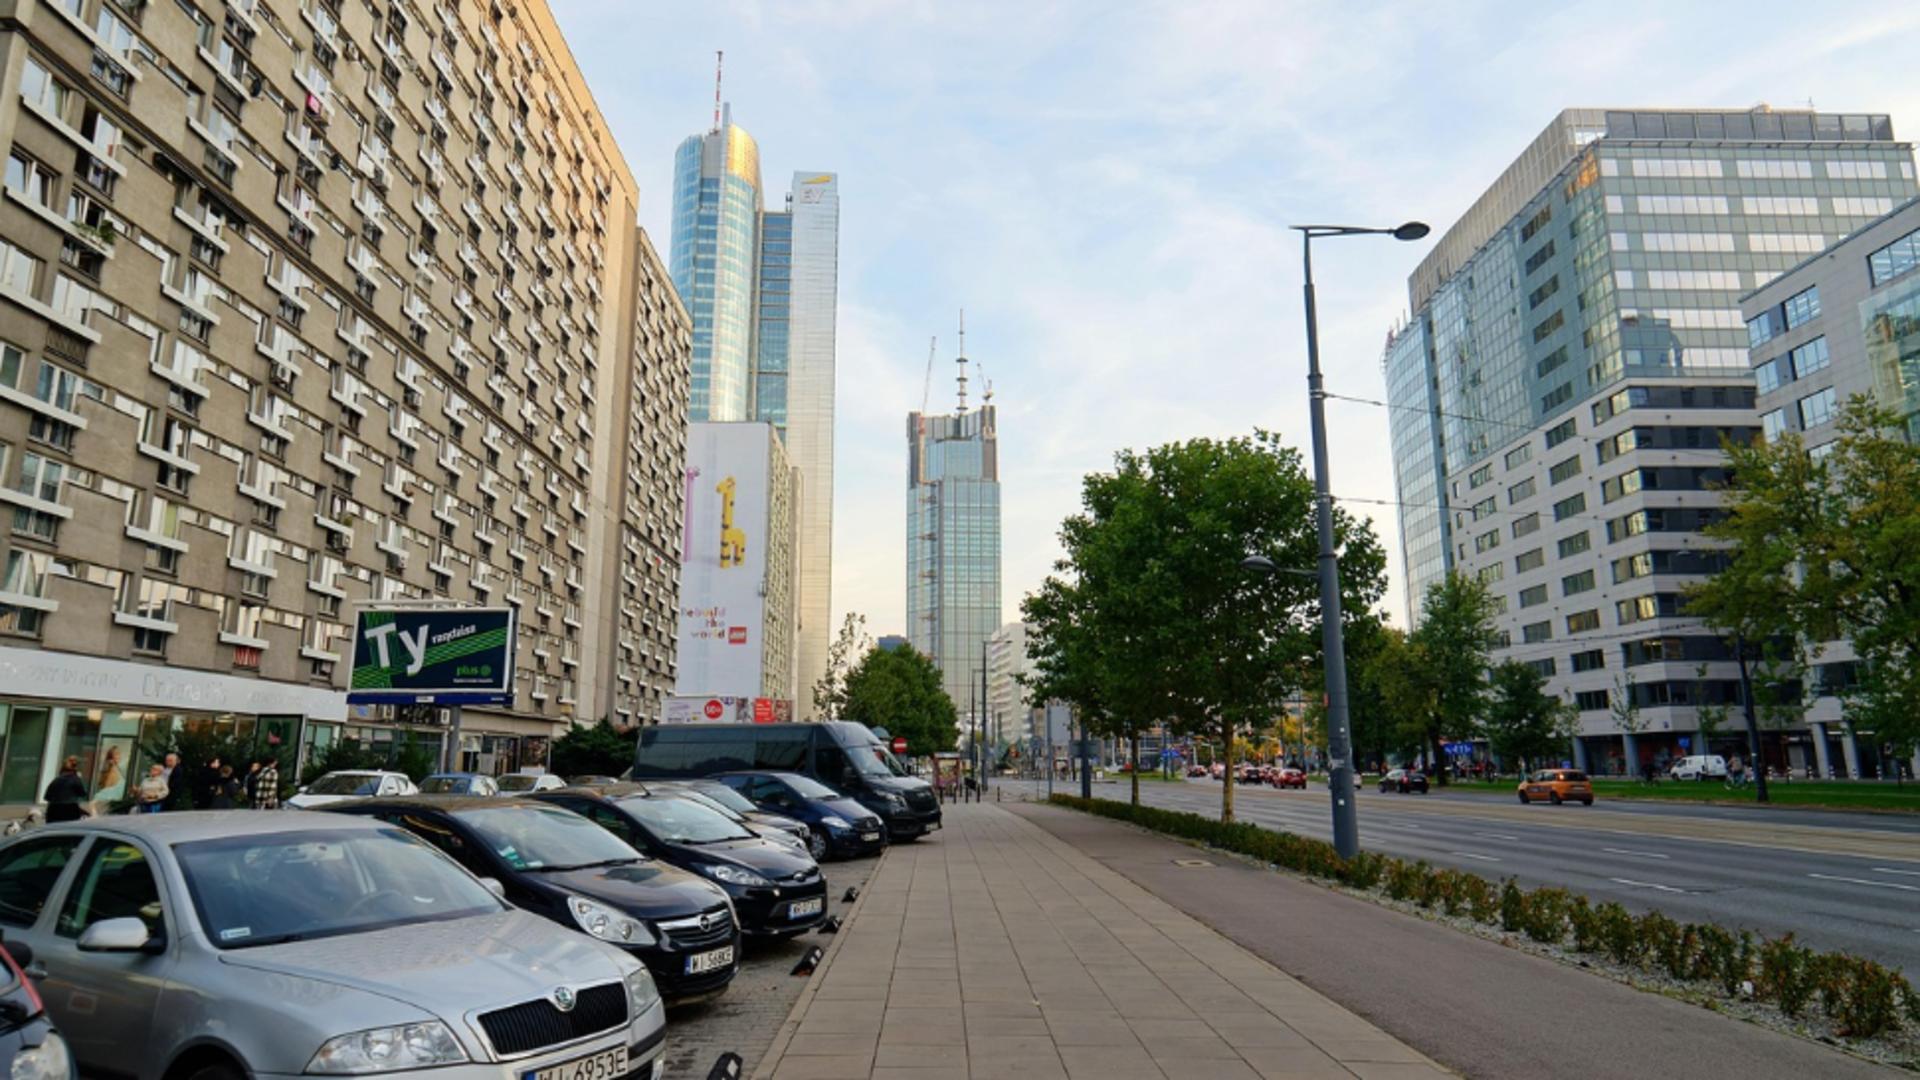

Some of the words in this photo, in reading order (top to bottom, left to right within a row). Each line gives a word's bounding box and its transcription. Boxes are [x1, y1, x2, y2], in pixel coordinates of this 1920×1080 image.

[365, 622, 430, 677] Ty
[456, 664, 479, 677] plus
[573, 1047, 627, 1080] 6953E
